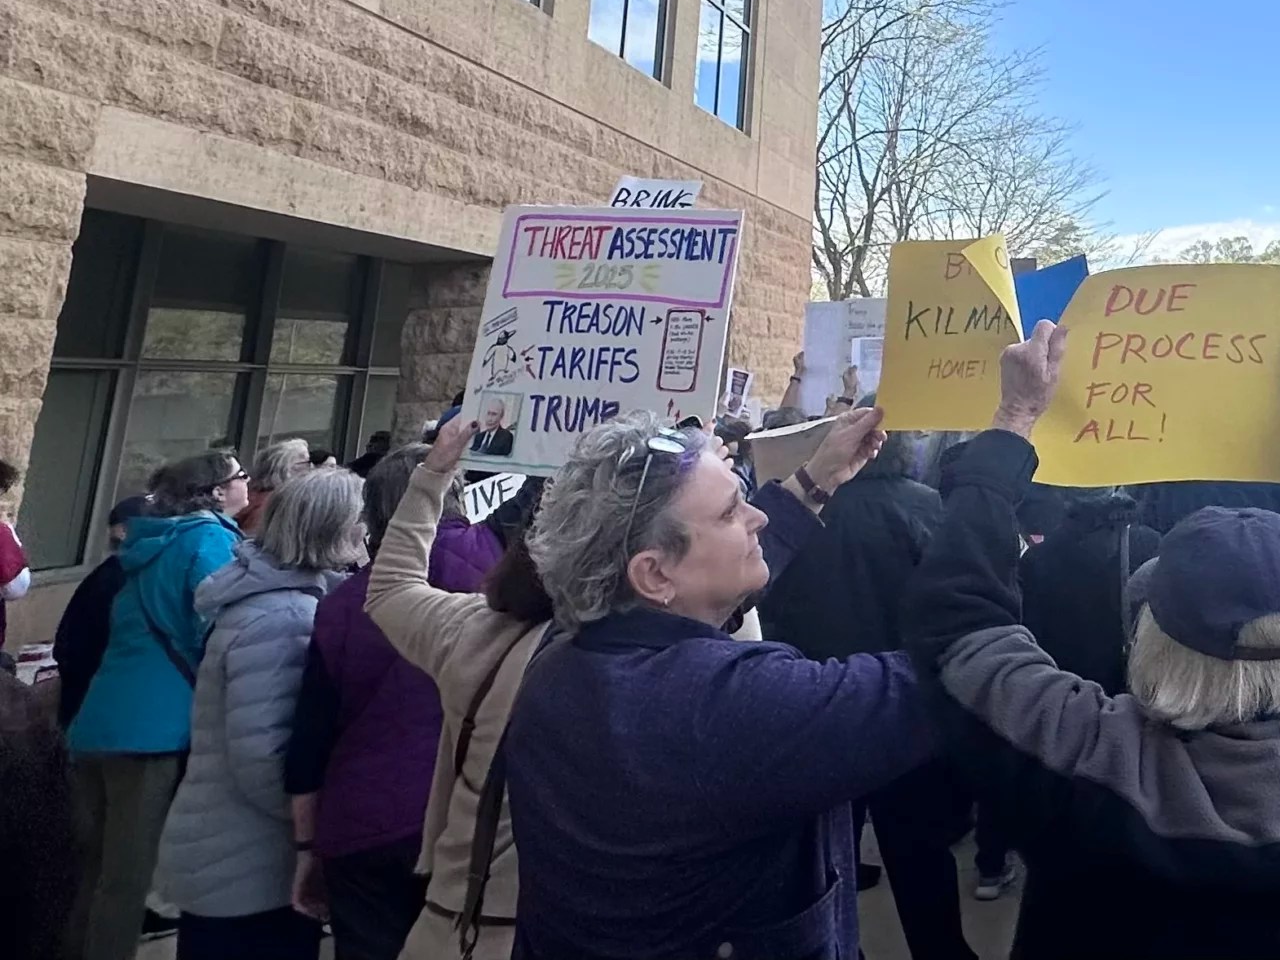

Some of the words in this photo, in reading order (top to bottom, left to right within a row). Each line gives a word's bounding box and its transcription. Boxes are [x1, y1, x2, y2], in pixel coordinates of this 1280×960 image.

[524, 225, 613, 260] THREAT
[607, 227, 738, 264] ASSESSMENT
[578, 262, 634, 290] 2025
[1105, 283, 1197, 317] DUE
[543, 300, 646, 337] TREASON
[537, 346, 640, 383] TARIFFS
[1091, 331, 1267, 370] PROCESS
[927, 357, 987, 380] HOME!
[530, 394, 620, 432] TRUMP
[1085, 382, 1156, 409] FOR
[1074, 412, 1167, 444] ALL!
